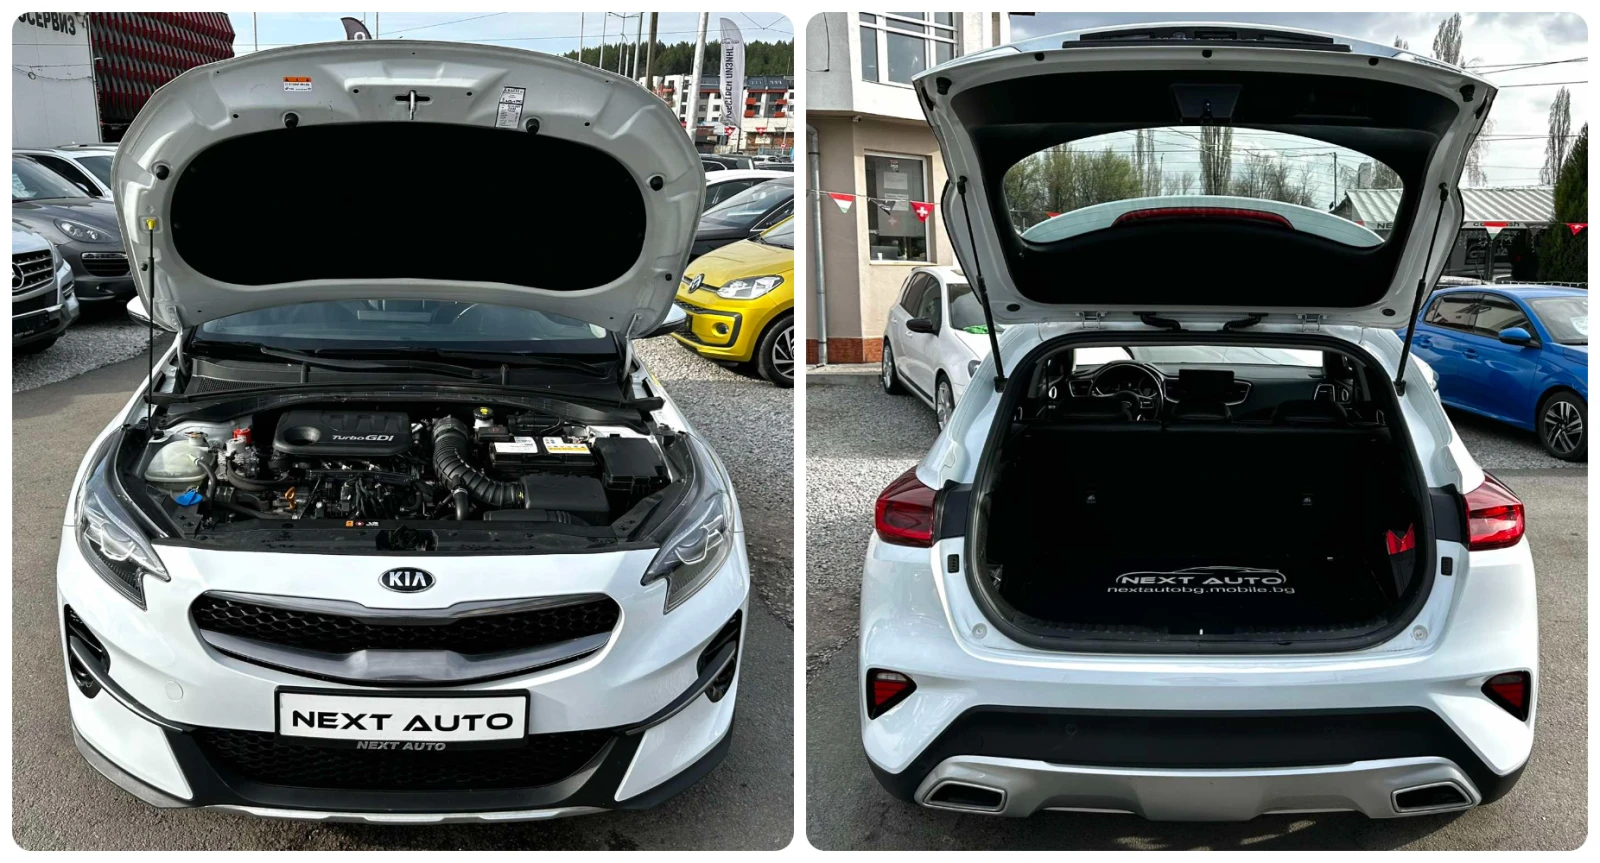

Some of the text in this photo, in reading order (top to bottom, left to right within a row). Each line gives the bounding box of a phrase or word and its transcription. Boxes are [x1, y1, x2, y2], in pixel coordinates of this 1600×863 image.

[389, 571, 427, 587] KIA
[1121, 576, 1282, 585] NEXT AUTO
[1107, 586, 1296, 594] nextautobg.mobile.bg
[292, 710, 514, 732] NEXT AUTO
[356, 740, 447, 751] NEXT AUTO
